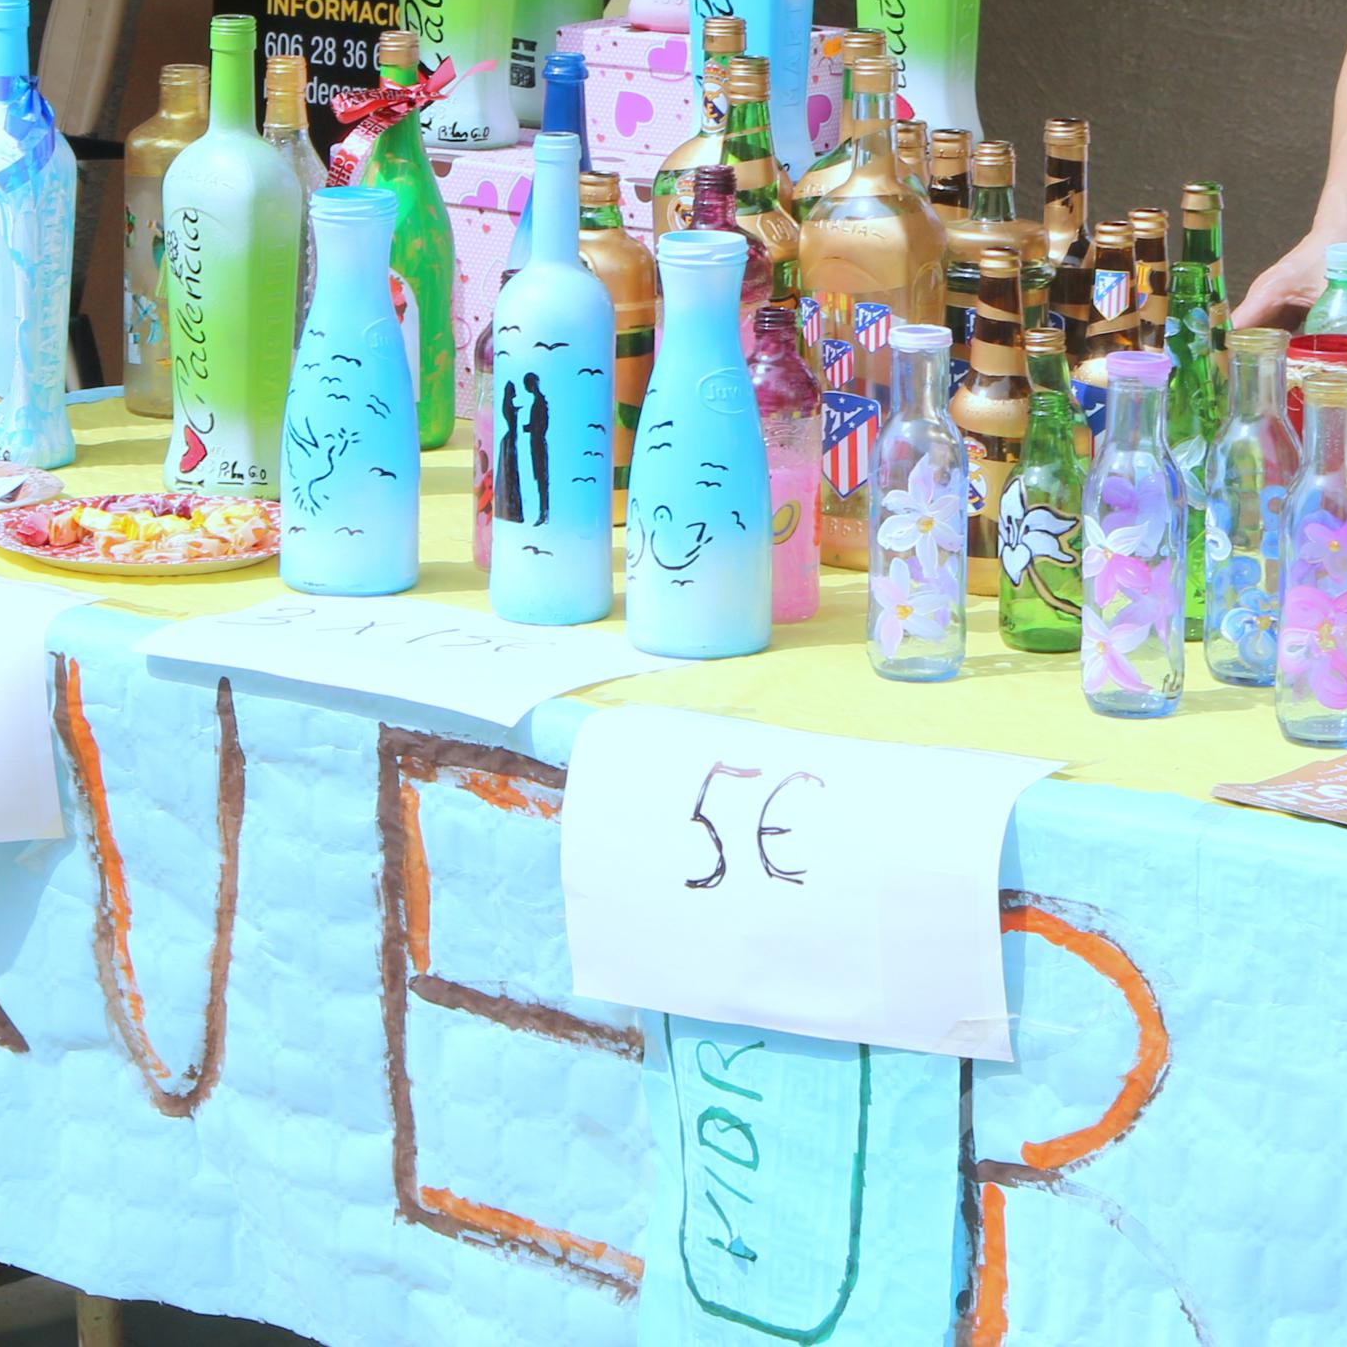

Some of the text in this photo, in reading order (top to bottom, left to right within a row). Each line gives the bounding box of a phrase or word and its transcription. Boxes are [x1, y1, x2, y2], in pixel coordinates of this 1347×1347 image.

[264, 31, 303, 61] 606
[310, 35, 336, 65] 28
[342, 38, 367, 68] 36
[684, 760, 825, 888] 5€
